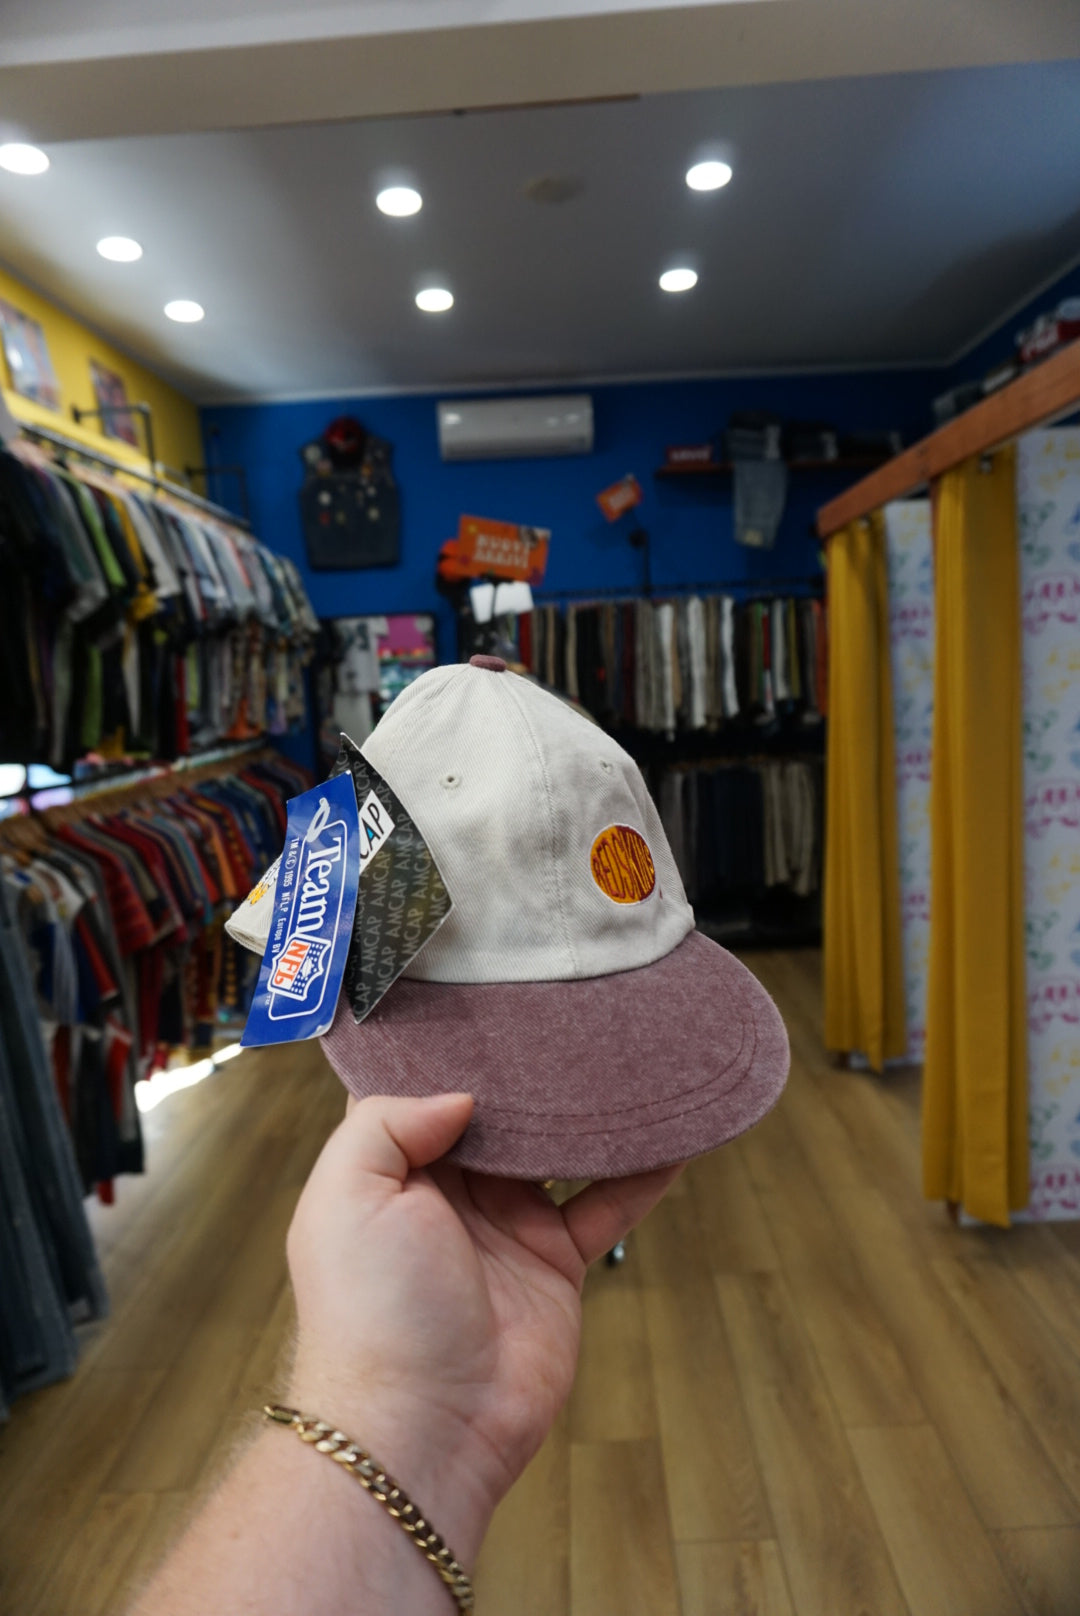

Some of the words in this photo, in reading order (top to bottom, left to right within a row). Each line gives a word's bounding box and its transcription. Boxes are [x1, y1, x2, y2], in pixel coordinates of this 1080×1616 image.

[395, 813, 413, 870] AMCAP
[296, 837, 341, 934] Team
[370, 850, 392, 907] AMCAP
[385, 879, 408, 938] AMCAP
[274, 941, 310, 985] NFL
[361, 915, 382, 975] AMCAP
